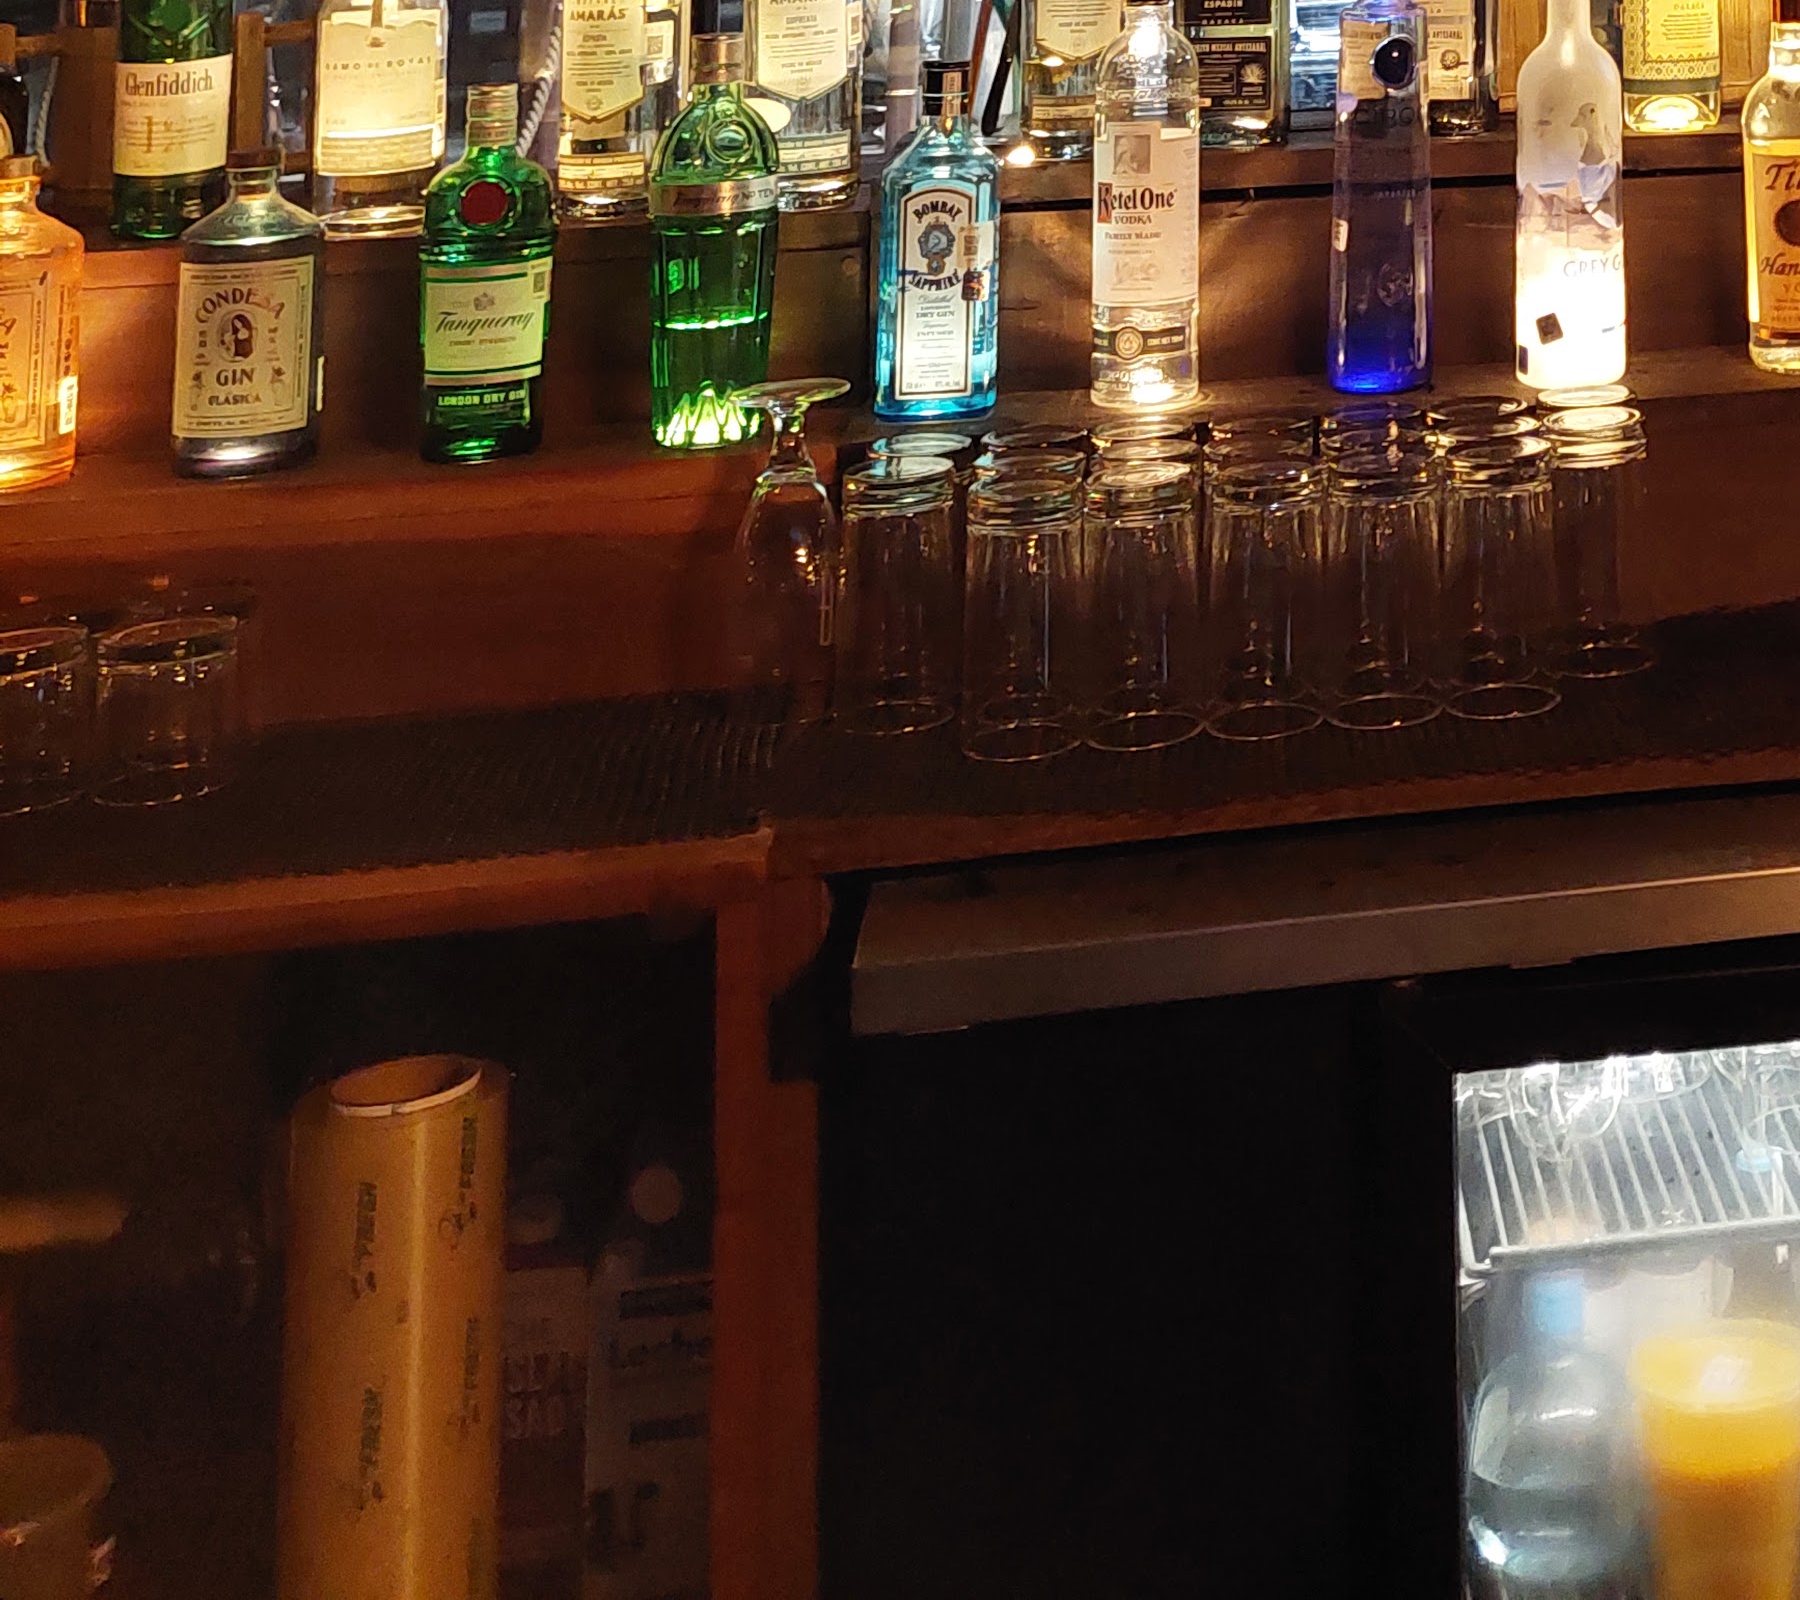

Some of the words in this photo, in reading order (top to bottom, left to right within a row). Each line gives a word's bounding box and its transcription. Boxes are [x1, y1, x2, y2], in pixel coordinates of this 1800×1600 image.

[569, 5, 627, 22] AMARÁS
[125, 68, 214, 97] Glenfiddich
[912, 199, 964, 224] BOMBAY
[1098, 184, 1137, 223] Ketel
[1139, 187, 1175, 211] One
[1114, 214, 1152, 226] VODKA
[908, 267, 963, 292] SAPPHIRE
[435, 311, 536, 337] Tanqueray
[215, 367, 256, 387] GIN
[437, 394, 481, 407] LONDON
